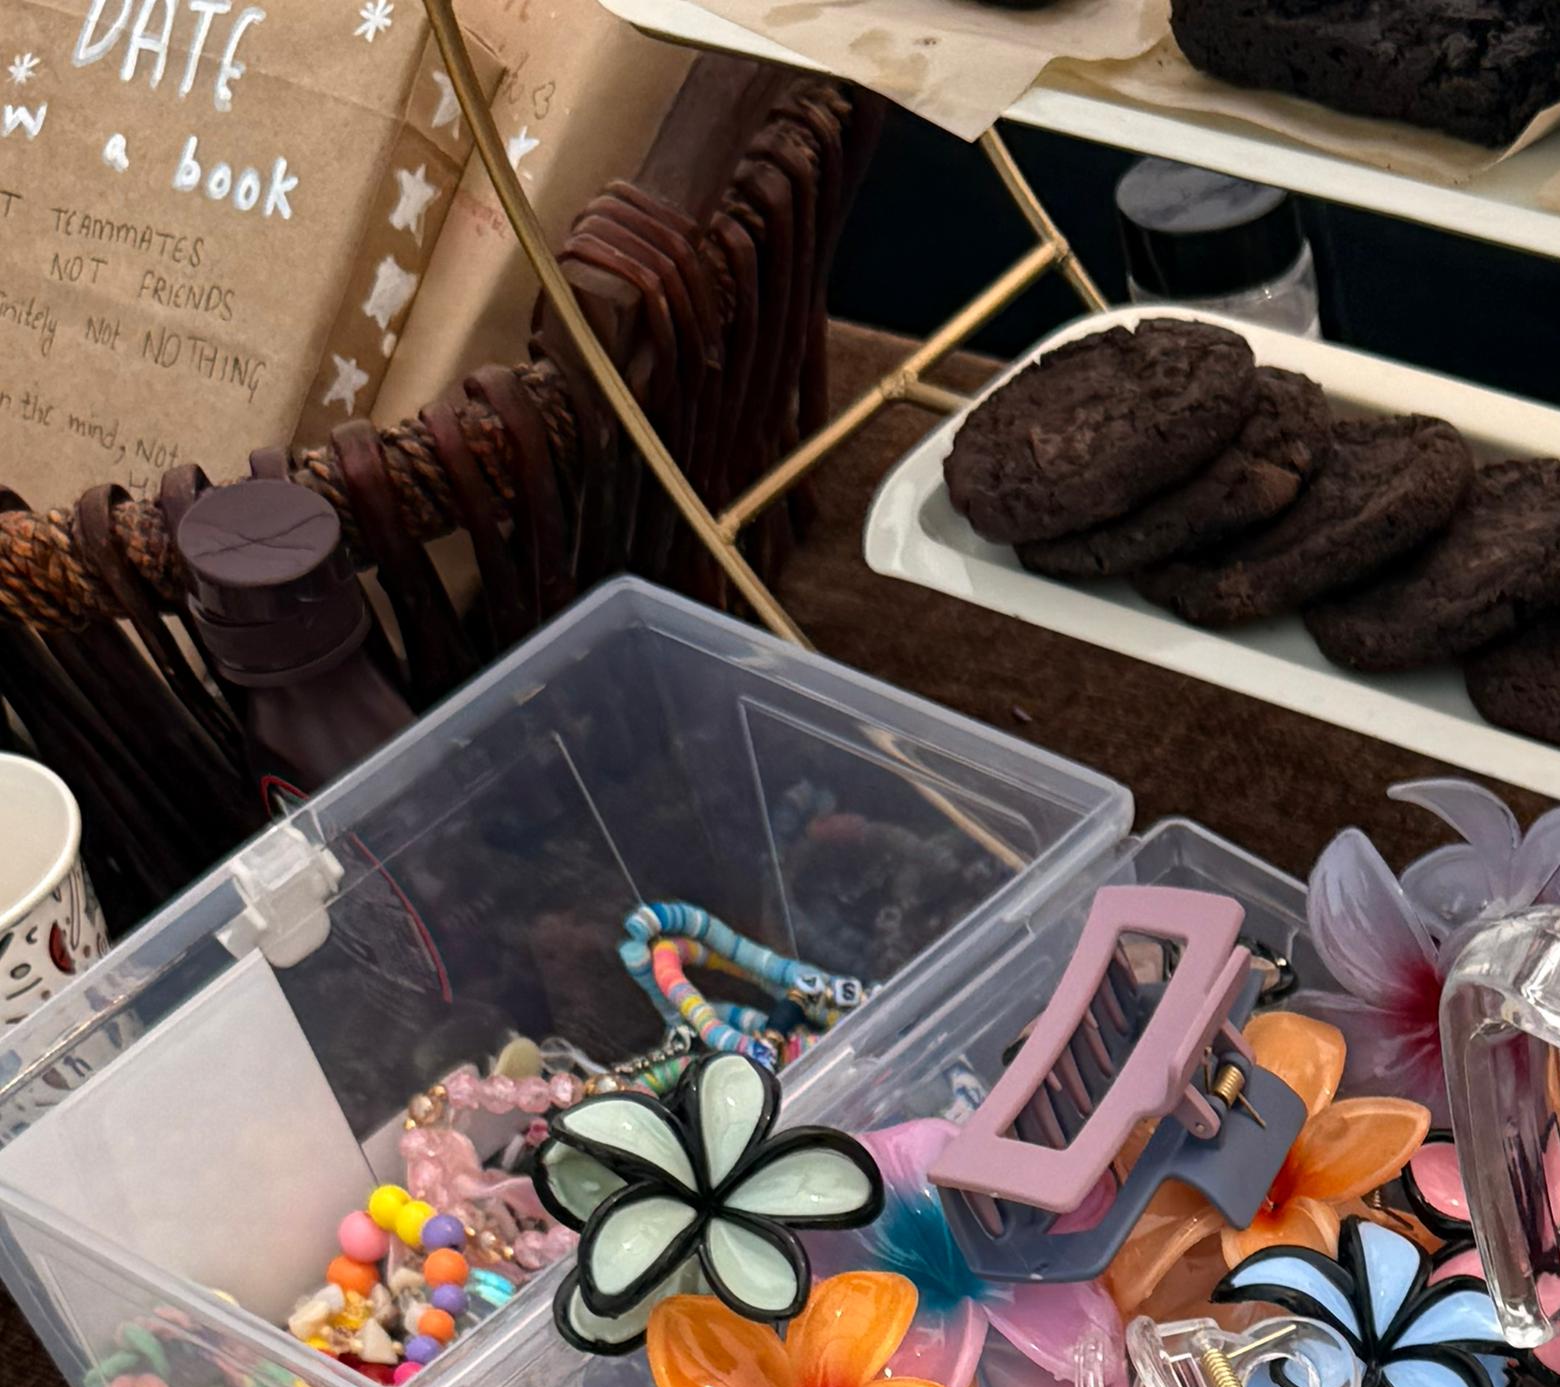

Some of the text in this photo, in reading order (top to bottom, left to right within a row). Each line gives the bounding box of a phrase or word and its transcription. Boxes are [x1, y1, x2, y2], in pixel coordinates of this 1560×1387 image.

[72, 0, 266, 112] DATE
[104, 133, 129, 173] a
[172, 135, 299, 220] book
[51, 207, 204, 268] TEAMMATES
[50, 253, 235, 322] NOT FRIENDS
[85, 316, 121, 350] Not
[143, 327, 266, 403] NOTHING
[21, 390, 54, 426] the
